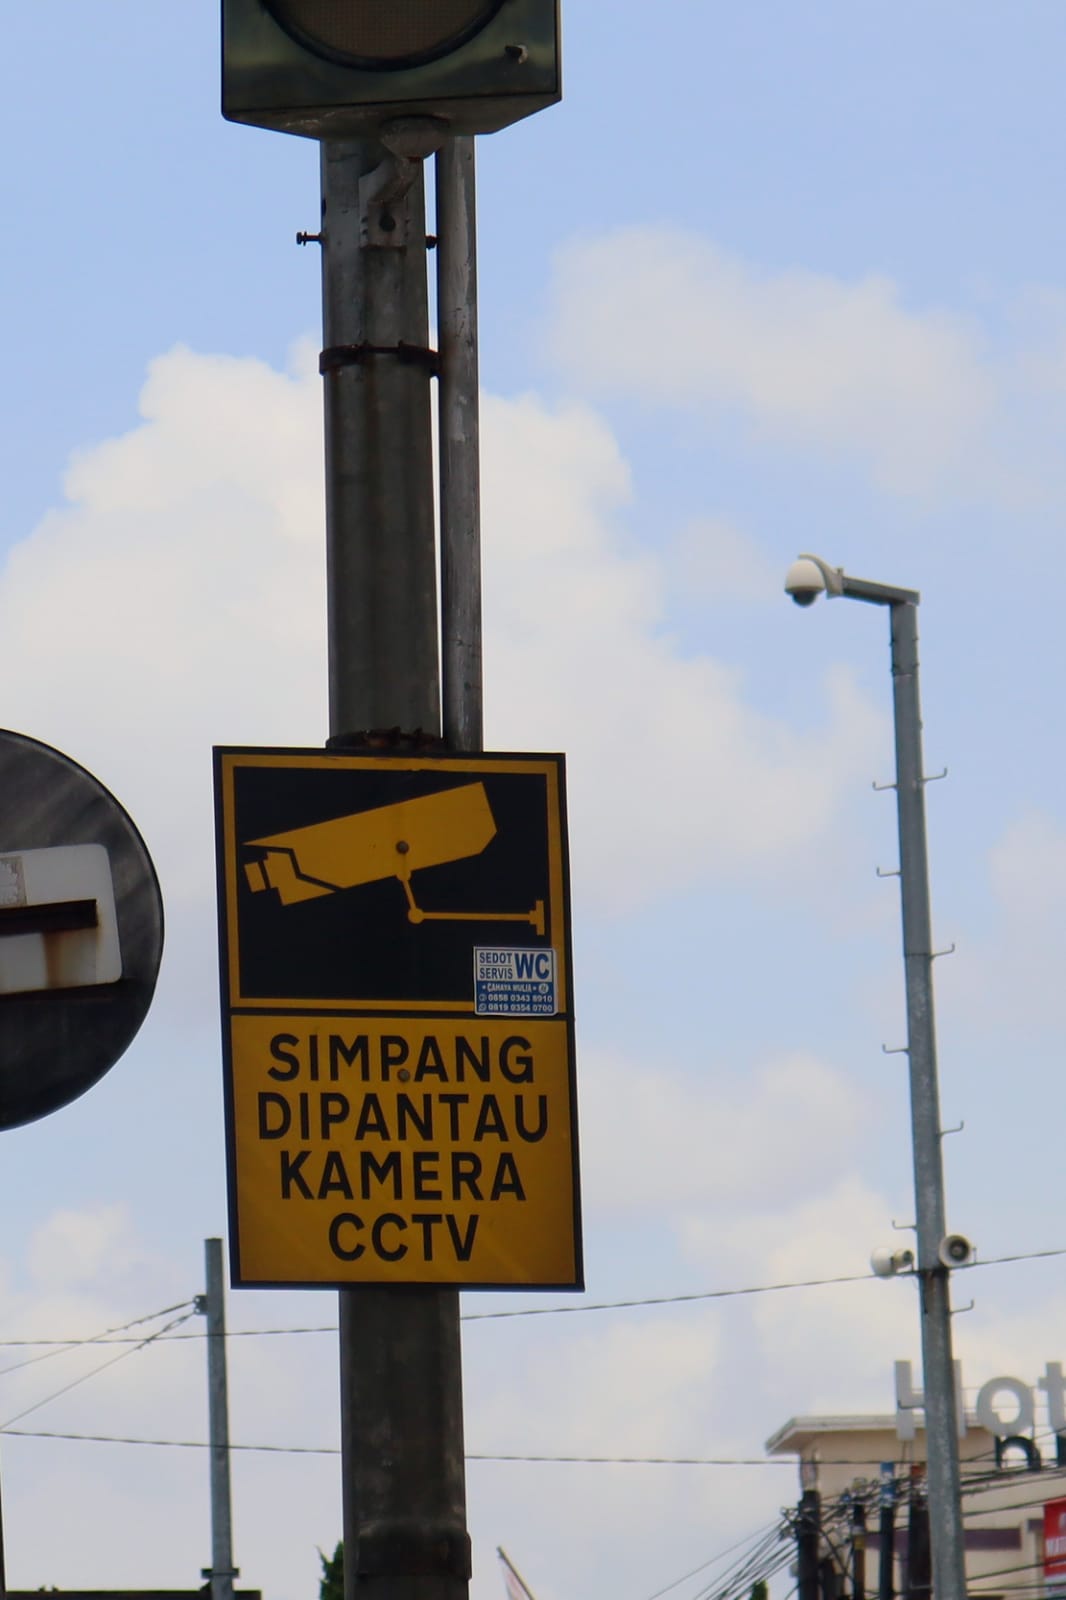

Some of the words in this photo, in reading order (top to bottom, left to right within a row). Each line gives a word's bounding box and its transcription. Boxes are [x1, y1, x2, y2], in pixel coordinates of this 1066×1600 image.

[479, 952, 513, 964] SEDOT
[479, 967, 513, 979] SERVIS
[514, 952, 550, 980] WC
[267, 1034, 534, 1083] SIMPANG
[258, 1092, 548, 1143] DIPANTAU
[280, 1150, 527, 1201] KAMERA
[328, 1212, 480, 1262] CCTV
